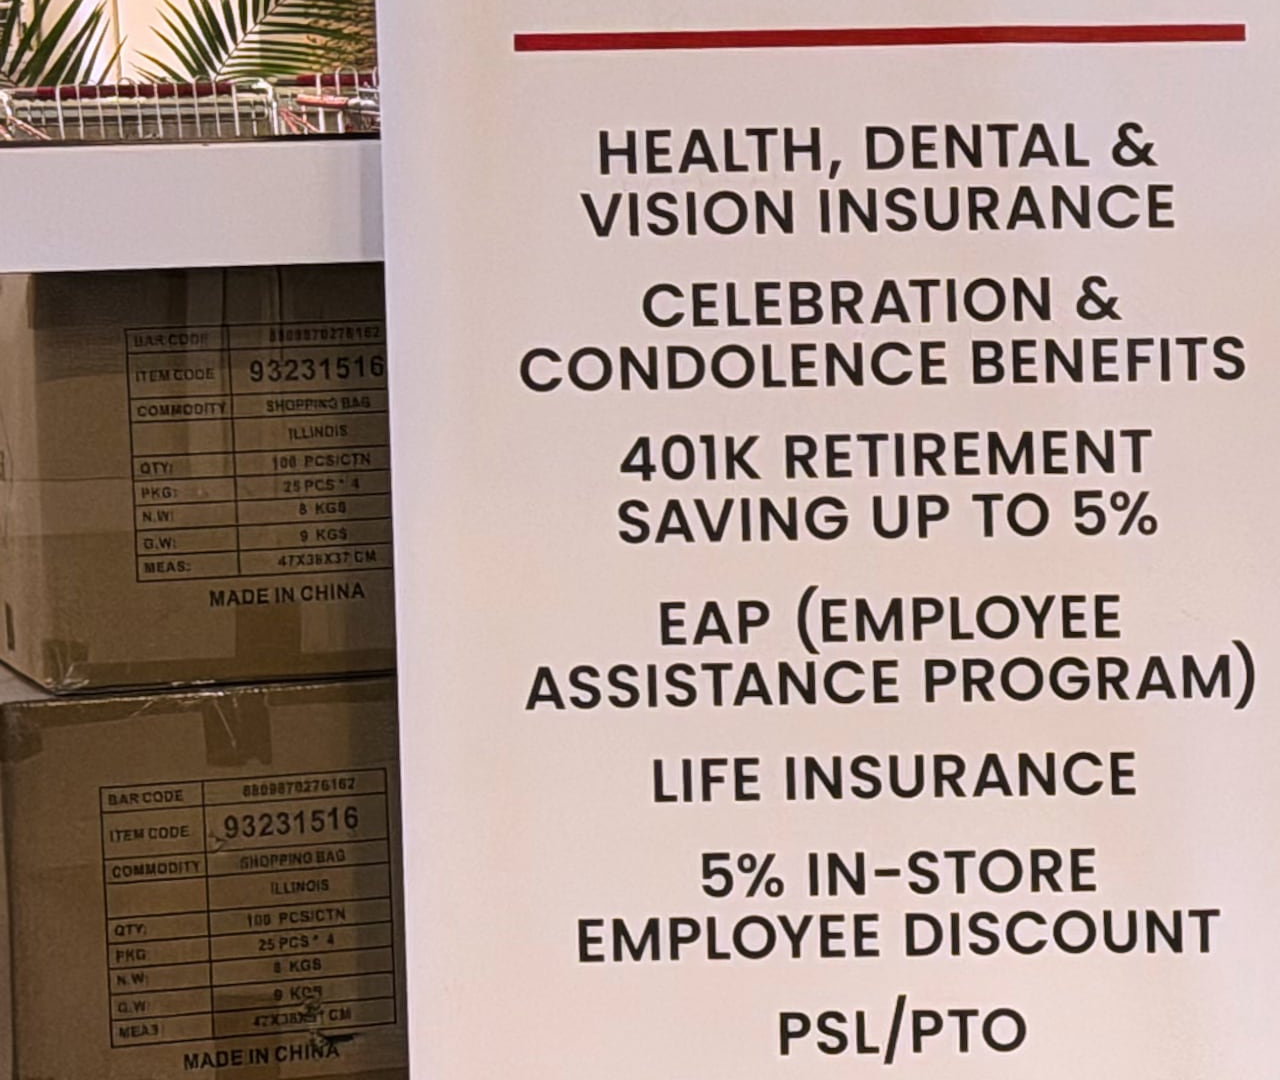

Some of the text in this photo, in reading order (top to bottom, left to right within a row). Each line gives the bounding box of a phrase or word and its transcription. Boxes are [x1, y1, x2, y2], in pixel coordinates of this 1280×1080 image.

[598, 122, 1158, 180] HEALTH, DENTAL &
[581, 184, 1175, 237] VISION INSURANCE
[642, 275, 1122, 328] CELEBRATION &
[135, 368, 215, 383] ITEM CODE
[250, 355, 384, 383] 93231516
[520, 336, 1246, 392] CONDOLENCE BENEFITS
[137, 402, 227, 418] COMMODITY
[266, 396, 371, 413] SHOPPING BAG
[288, 424, 348, 441] ILLINOIS
[620, 429, 1152, 481] 401K RETIREMENT
[283, 479, 300, 494] 25
[304, 478, 335, 492] PCS
[351, 478, 360, 490] 4
[299, 501, 347, 516] 8 KGS
[618, 490, 1158, 544] SAVING UP TO 5%
[300, 527, 348, 542] 9 KGS
[354, 549, 376, 563] CM
[209, 582, 366, 607] MADE IN CHINA
[660, 586, 1121, 656] EAP (EMPLOYEE
[526, 641, 1256, 710] ASSISTANCE PROGRAM)
[653, 751, 1136, 803] LIFE INSURANCE
[108, 789, 184, 807] BAR CODE
[109, 825, 190, 843] ITEM CODE
[223, 806, 359, 839] 93231516
[111, 860, 201, 879] COMMODITY
[239, 849, 346, 870] SHOPPING BAG
[702, 848, 1096, 898] 5% IN-STORE
[270, 879, 329, 896] ILLINOIS
[258, 938, 276, 952] 25
[279, 935, 309, 950] PCS
[326, 933, 335, 947] 4
[578, 909, 1220, 963] EMPLOYEE DISCOUNT
[289, 957, 322, 972] KGS
[779, 994, 1027, 1066] PSL/PTO
[183, 1038, 340, 1070] MADE IN CHINA
